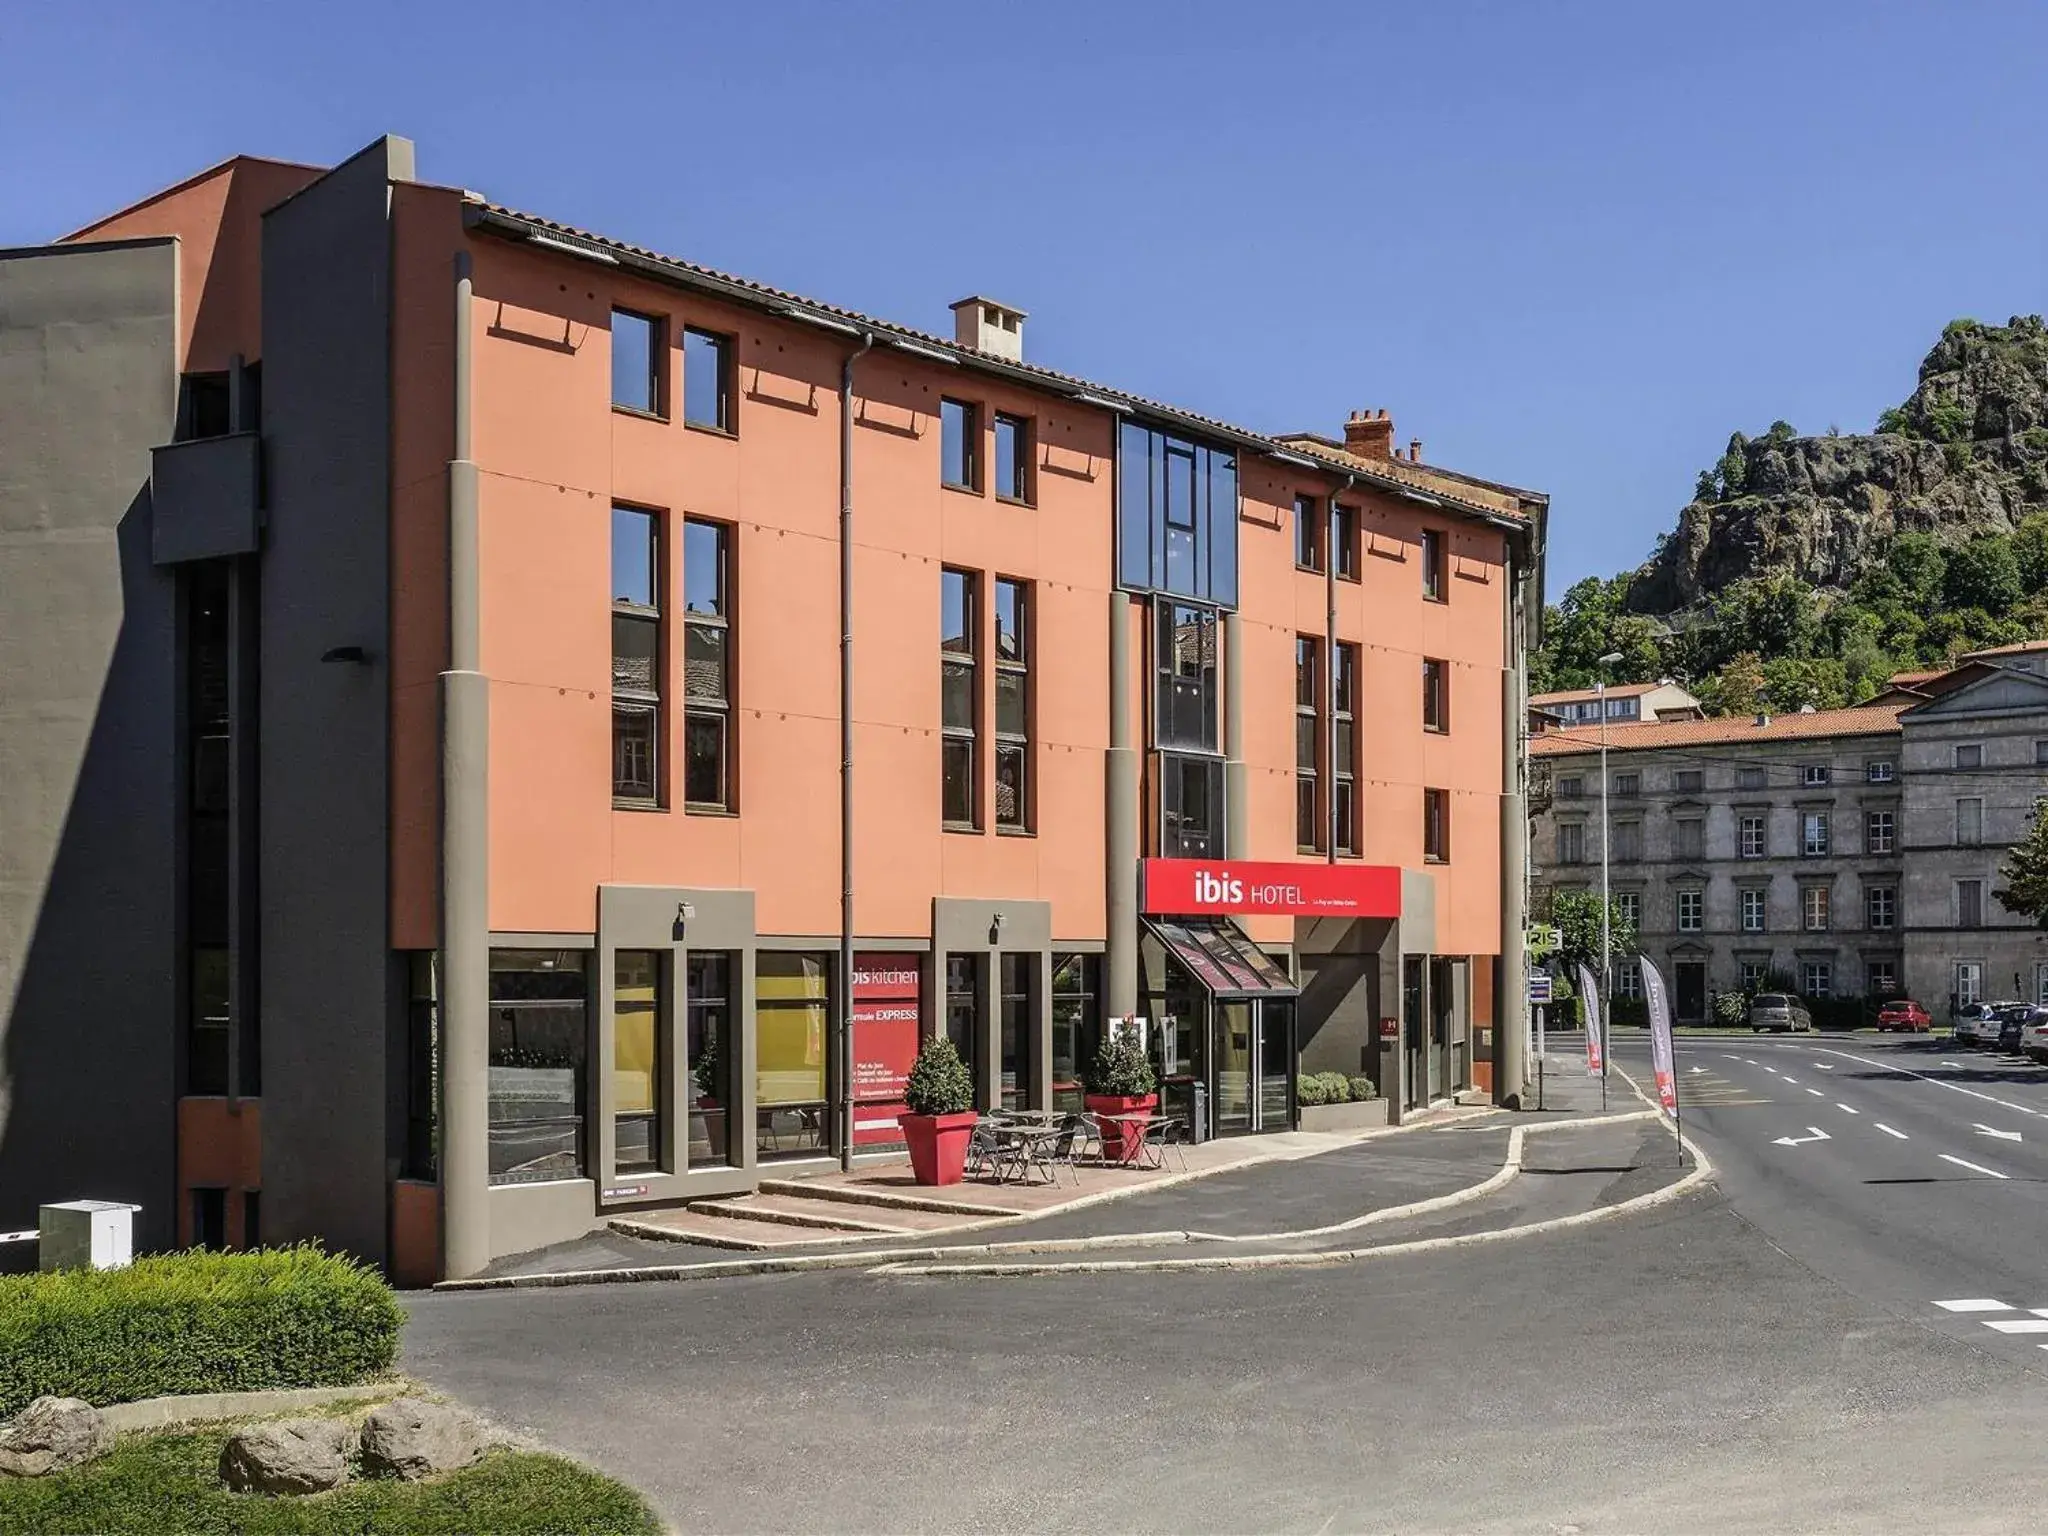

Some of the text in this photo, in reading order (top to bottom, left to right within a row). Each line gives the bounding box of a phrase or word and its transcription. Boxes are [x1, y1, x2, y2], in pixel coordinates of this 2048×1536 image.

[1195, 871, 1306, 905] ibis HOTEL
[871, 967, 918, 984] kitchen
[876, 1009, 918, 1021] EXPRESS
